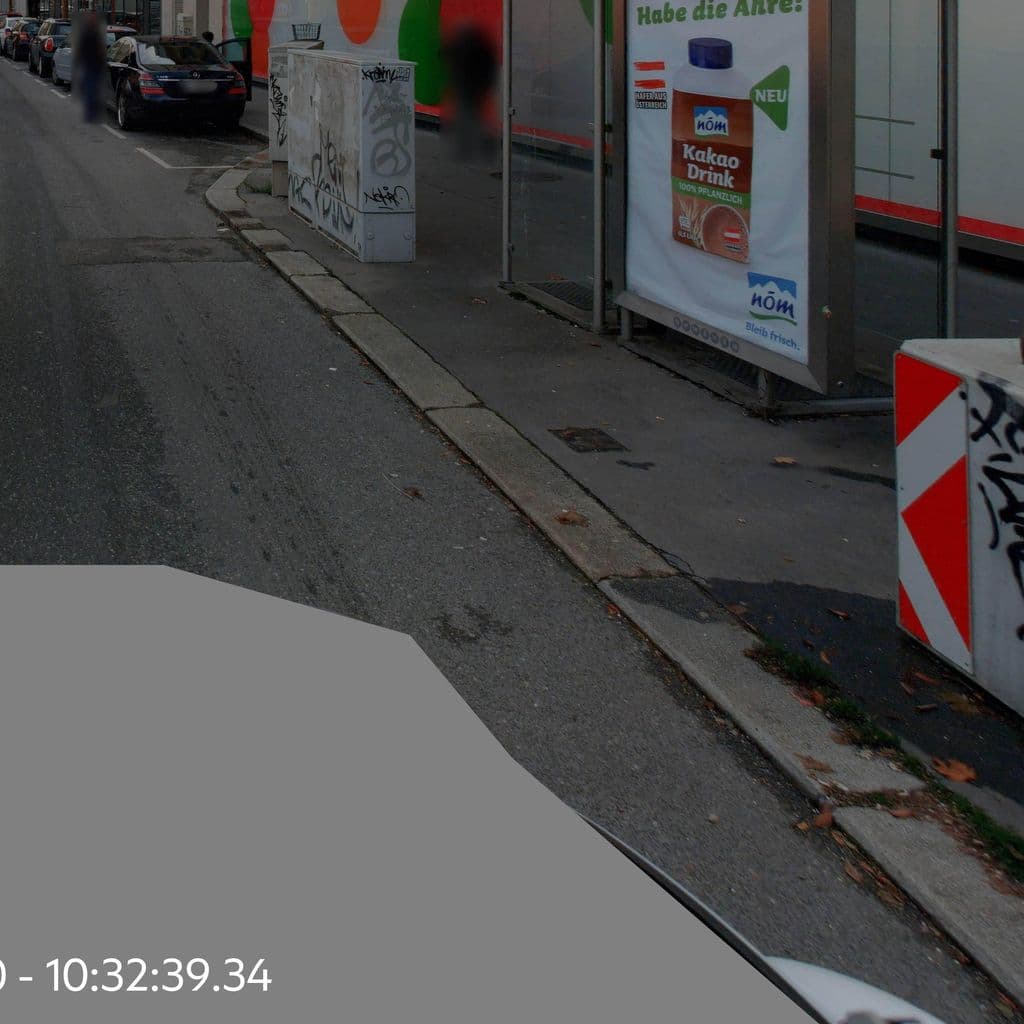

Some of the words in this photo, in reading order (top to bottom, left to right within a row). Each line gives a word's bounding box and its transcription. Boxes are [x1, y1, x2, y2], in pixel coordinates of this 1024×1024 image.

[636, 1, 687, 26] Habe
[754, 88, 787, 103] NEU
[682, 143, 740, 169] Kakao
[687, 162, 735, 189] Drink
[678, 182, 697, 193] 100%
[698, 186, 743, 205] PFLANZLICH
[745, 320, 769, 339] Bleib
[769, 329, 801, 352] frisch.
